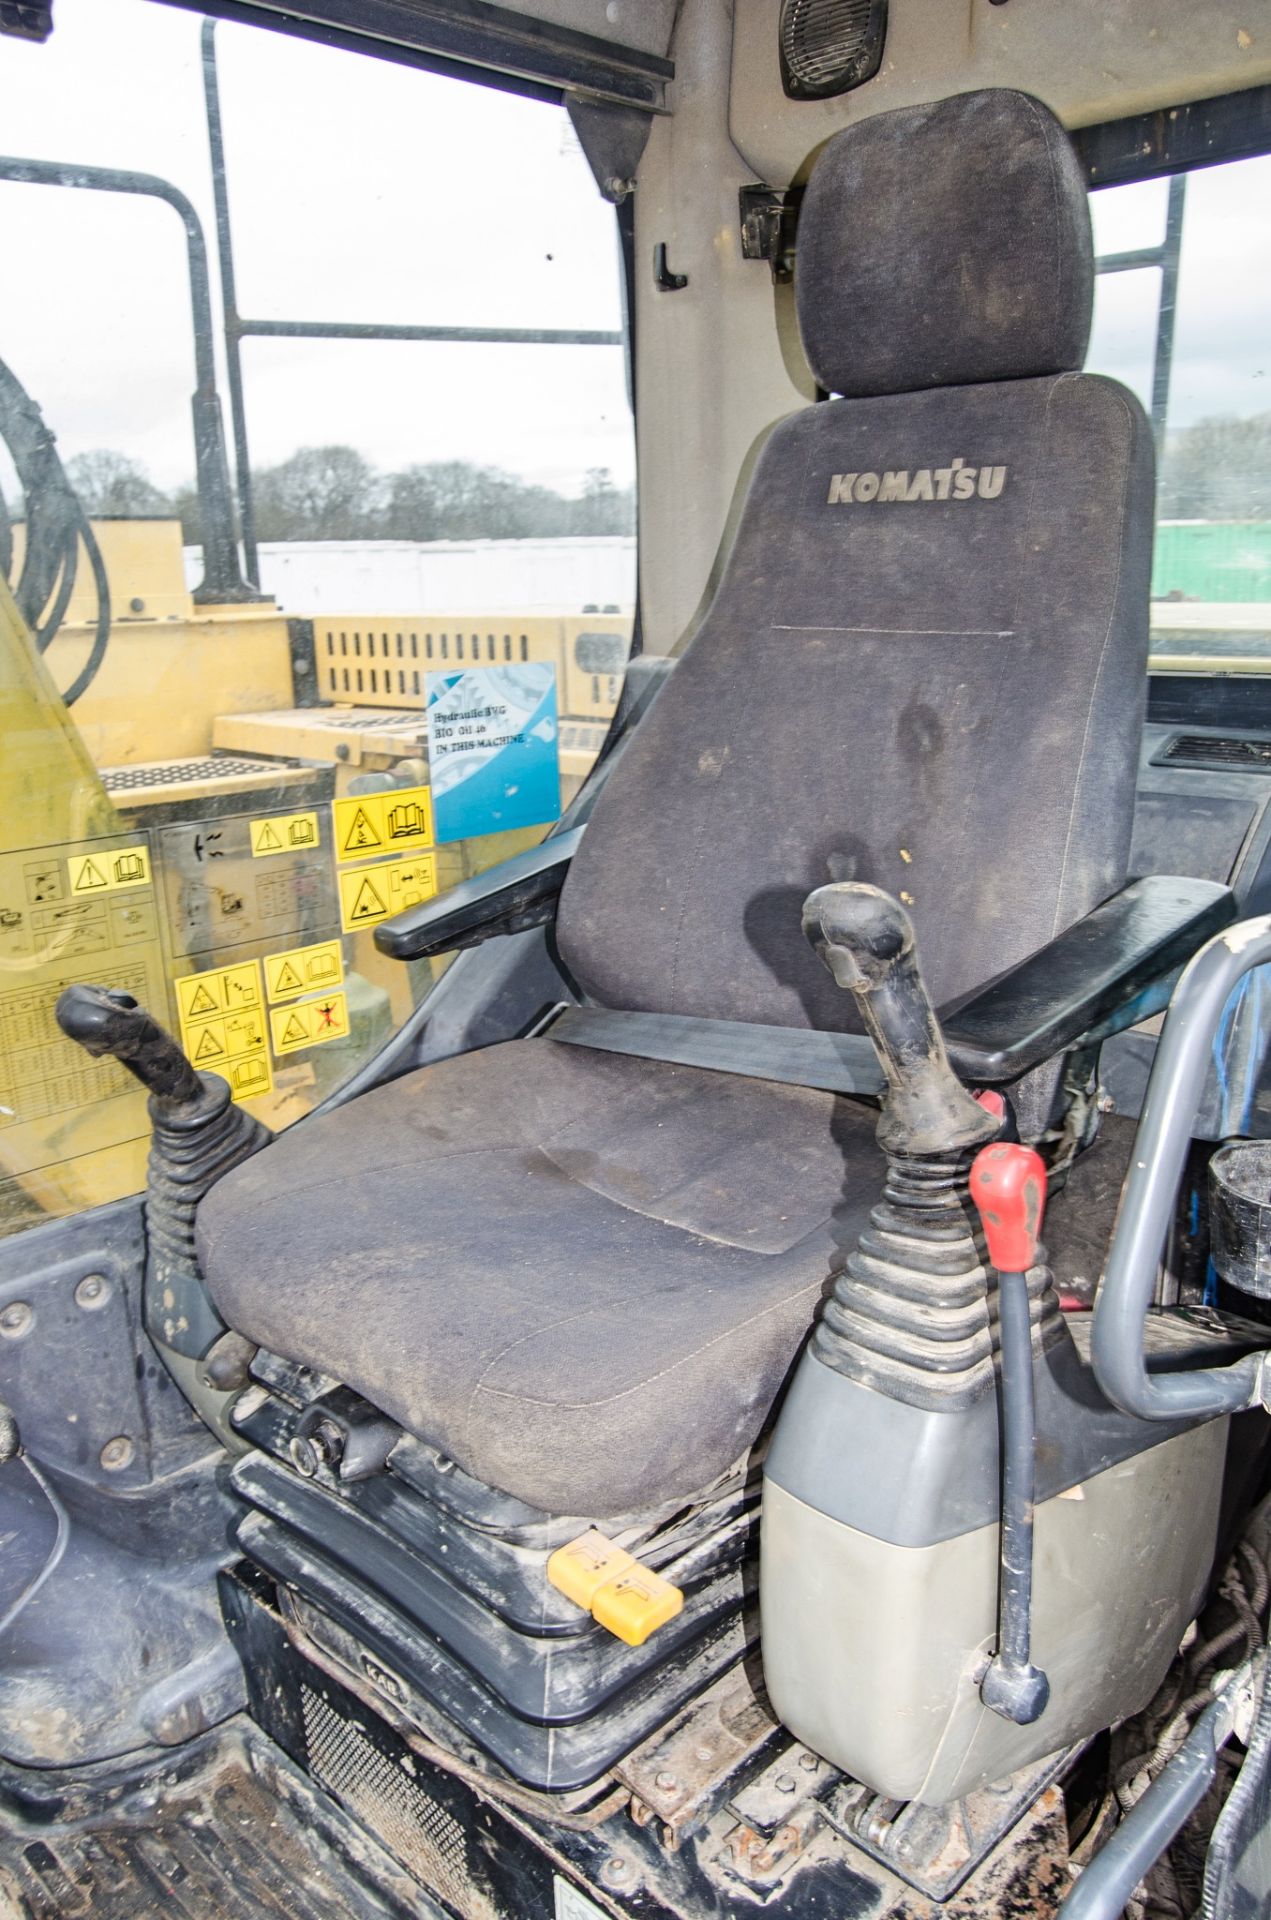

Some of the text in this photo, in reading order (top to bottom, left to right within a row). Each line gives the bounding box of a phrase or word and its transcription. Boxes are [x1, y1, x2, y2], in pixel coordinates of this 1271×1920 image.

[827, 458, 1008, 504] KOMATSU
[434, 708, 483, 723] Hydraulic
[436, 734, 524, 754] IN THIS MACHINE
